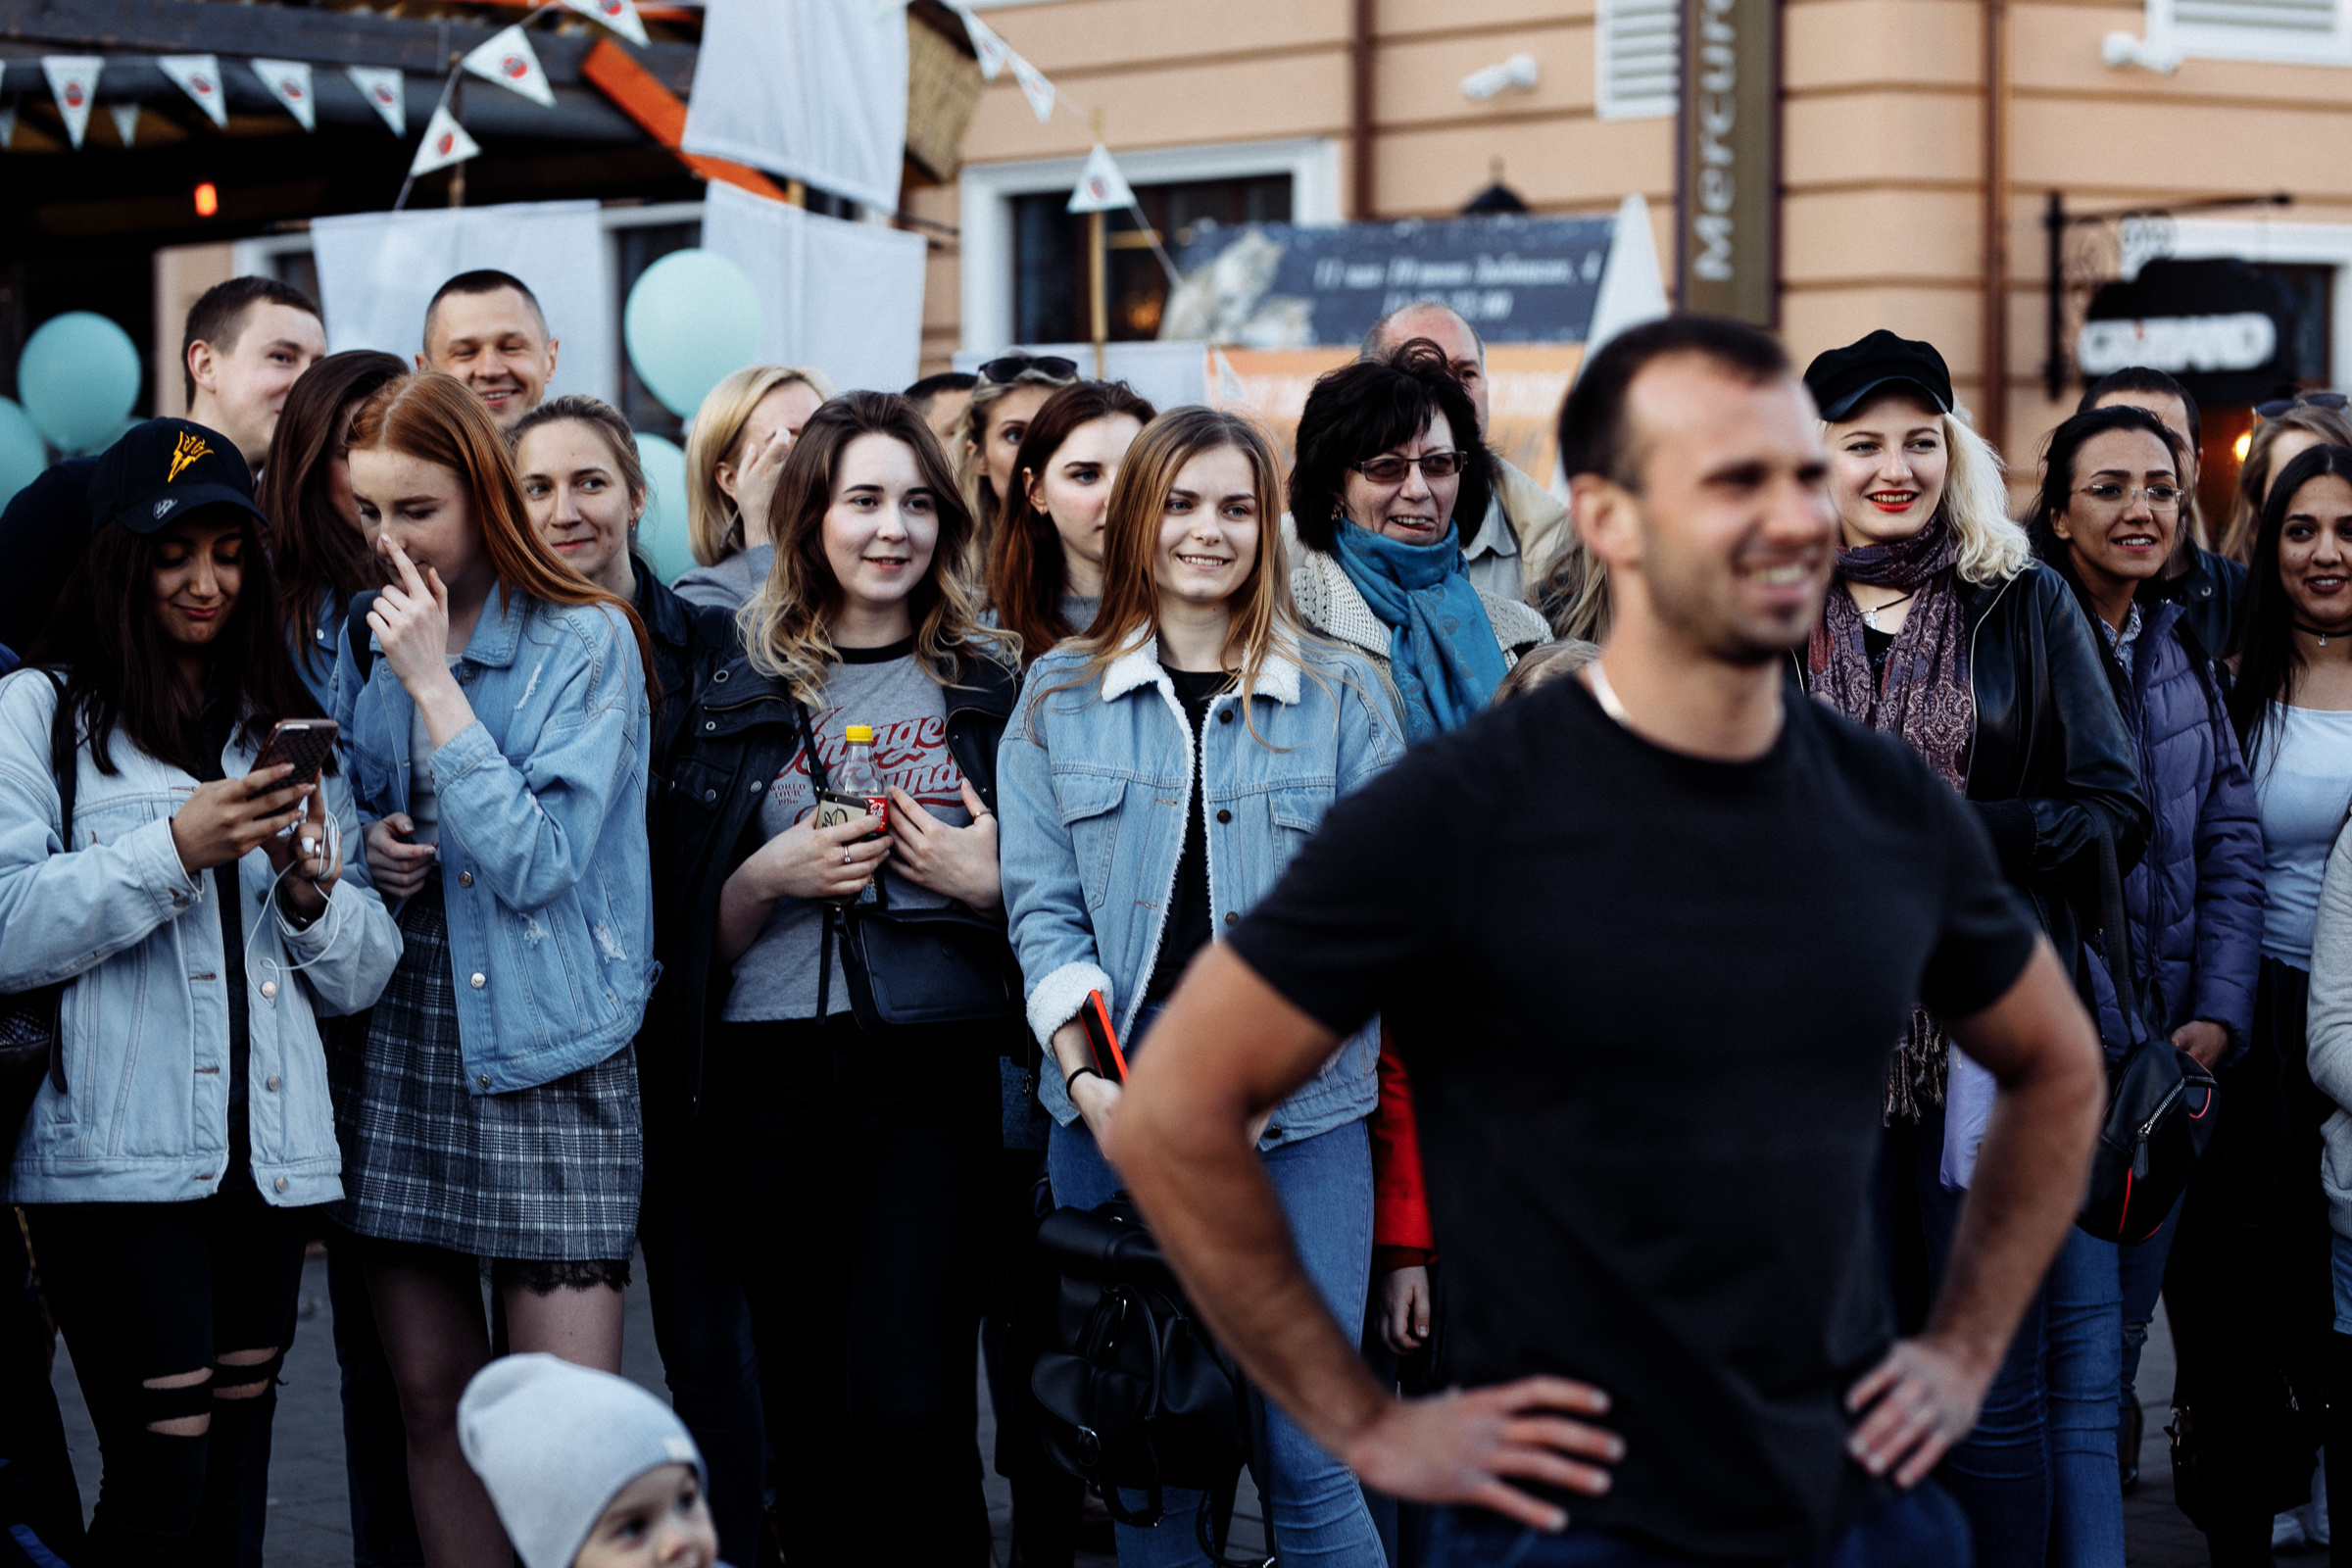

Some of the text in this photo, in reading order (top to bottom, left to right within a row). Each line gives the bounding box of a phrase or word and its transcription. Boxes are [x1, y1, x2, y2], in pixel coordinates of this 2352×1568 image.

[1694, 0, 1735, 279] Mercur
[768, 783, 806, 792] WORLD
[774, 790, 801, 799] TOUR
